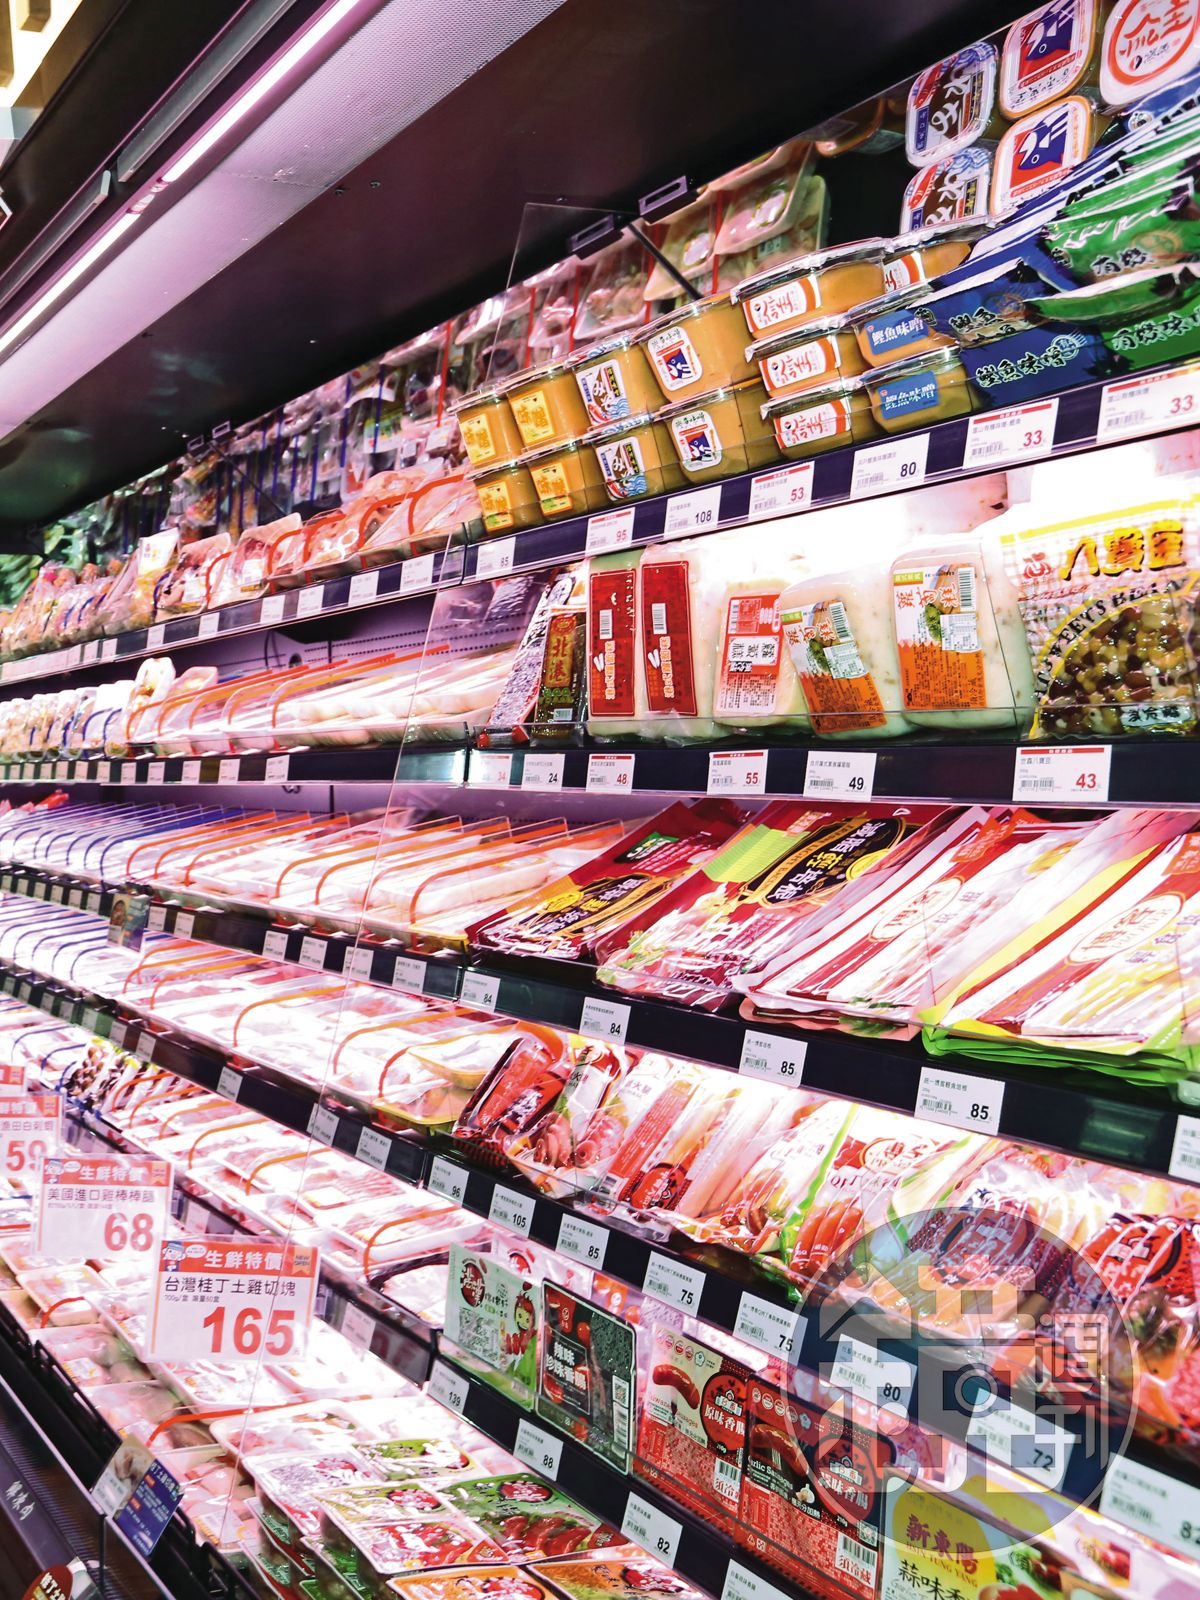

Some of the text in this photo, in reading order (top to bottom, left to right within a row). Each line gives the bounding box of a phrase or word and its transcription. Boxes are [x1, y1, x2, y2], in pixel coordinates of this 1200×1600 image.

[1171, 394, 1194, 414] 33
[1023, 430, 1043, 447] 33
[900, 461, 917, 478] 80
[790, 487, 804, 501] 53
[695, 510, 712, 524] 108
[548, 773, 559, 784] 24
[616, 773, 628, 785] 48
[745, 772, 759, 785] 55
[848, 777, 865, 791] 49
[1076, 773, 1098, 789] 43
[609, 1023, 621, 1035] 84
[781, 1062, 796, 1075] 85
[971, 1103, 990, 1120] 85
[452, 1185, 461, 1198] 96
[512, 1213, 527, 1228] 105
[104, 1212, 154, 1252] 68
[204, 1250, 284, 1271] 生鮮特價
[588, 1246, 600, 1259] 85
[165, 1276, 296, 1297] 台灣桂丁土雞切塊
[681, 1289, 694, 1304] 75
[202, 1306, 296, 1356] 165
[778, 1334, 794, 1352] 75
[883, 1382, 900, 1401] 80
[543, 1454, 554, 1469] 88
[1033, 1449, 1054, 1468] 72
[657, 1537, 670, 1554] 82
[906, 1513, 979, 1575] 新東陽
